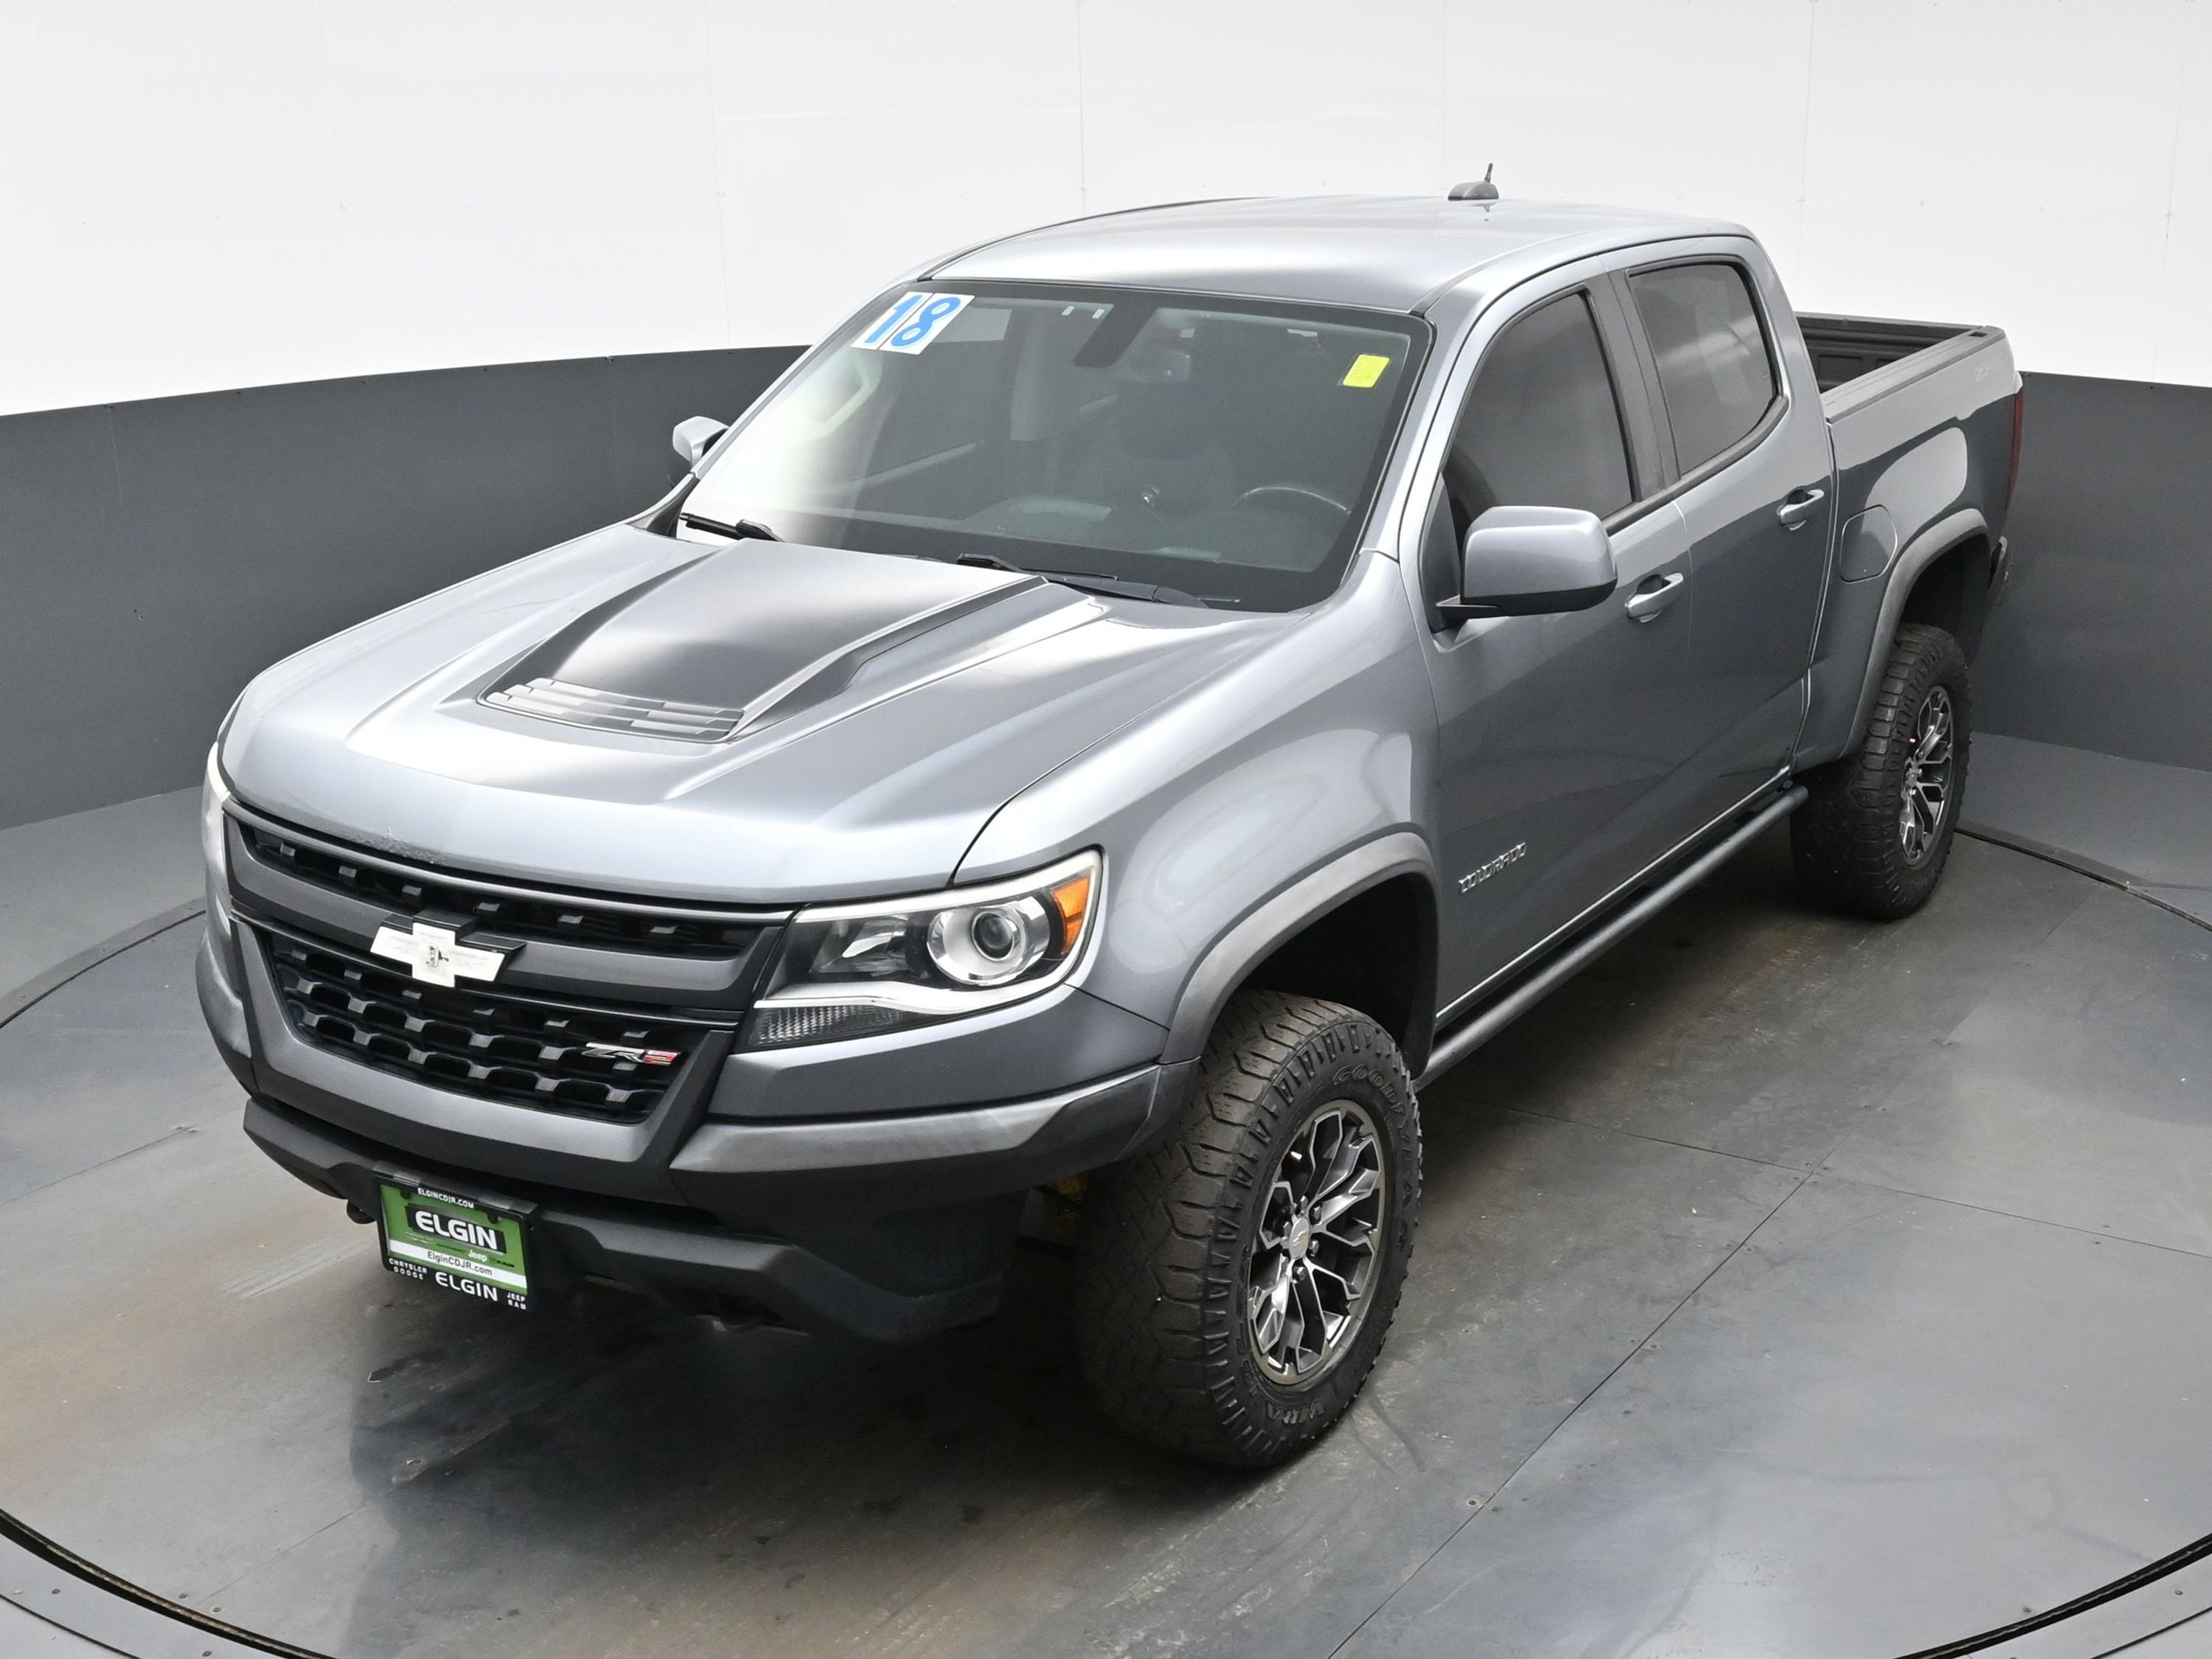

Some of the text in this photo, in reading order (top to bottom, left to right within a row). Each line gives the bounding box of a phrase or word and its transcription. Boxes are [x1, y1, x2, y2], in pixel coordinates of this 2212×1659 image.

[863, 294, 962, 349] 18
[581, 1042, 680, 1066] ZR2
[417, 1187, 474, 1209] ELGINCDJR.COM
[415, 1210, 498, 1250] ELGIN
[389, 1258, 427, 1274] CHRYSLER
[427, 1251, 493, 1276] ElginCDJR.com
[467, 1249, 487, 1262] Jeep
[393, 1266, 424, 1280] DODGE
[435, 1271, 498, 1301] ELGIN
[507, 1292, 526, 1302] JEEP
[508, 1299, 526, 1310] RAM
